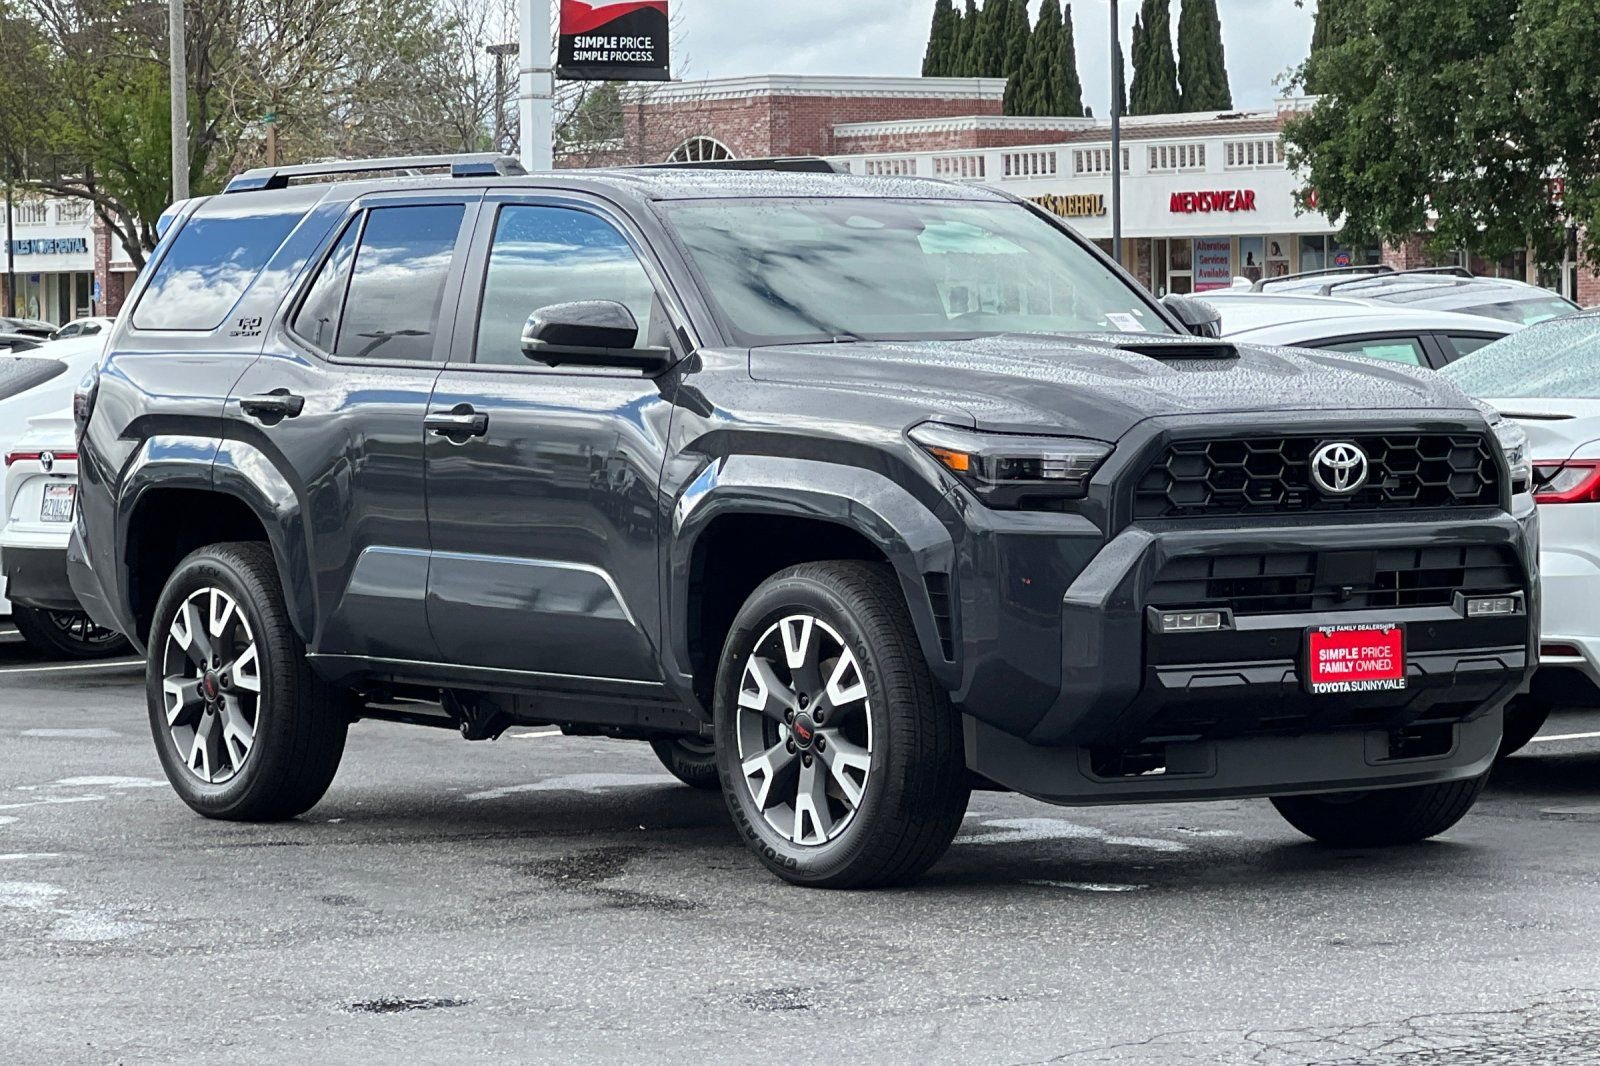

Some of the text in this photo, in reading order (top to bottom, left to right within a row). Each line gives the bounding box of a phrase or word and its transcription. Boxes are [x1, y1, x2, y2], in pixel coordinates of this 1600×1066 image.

[574, 36, 655, 49] SIMPLE PRICE.
[573, 50, 655, 62] SIMPLE PROCESS.
[1056, 194, 1107, 217] MEHFIL
[1169, 189, 1257, 213] MENSWEAR
[55, 238, 89, 254] DENTAL
[1197, 240, 1230, 250] Alteration
[1199, 254, 1228, 265] Services
[1335, 256, 1350, 264] OPEN
[1199, 267, 1230, 278] Available
[1357, 623, 1396, 631] DEALERSHIPS
[1319, 646, 1393, 661] SIMPLE PRICE.
[1320, 659, 1394, 674] FAMILY OWNED.
[1312, 678, 1406, 694] TOYOTA SUNNYVALE
